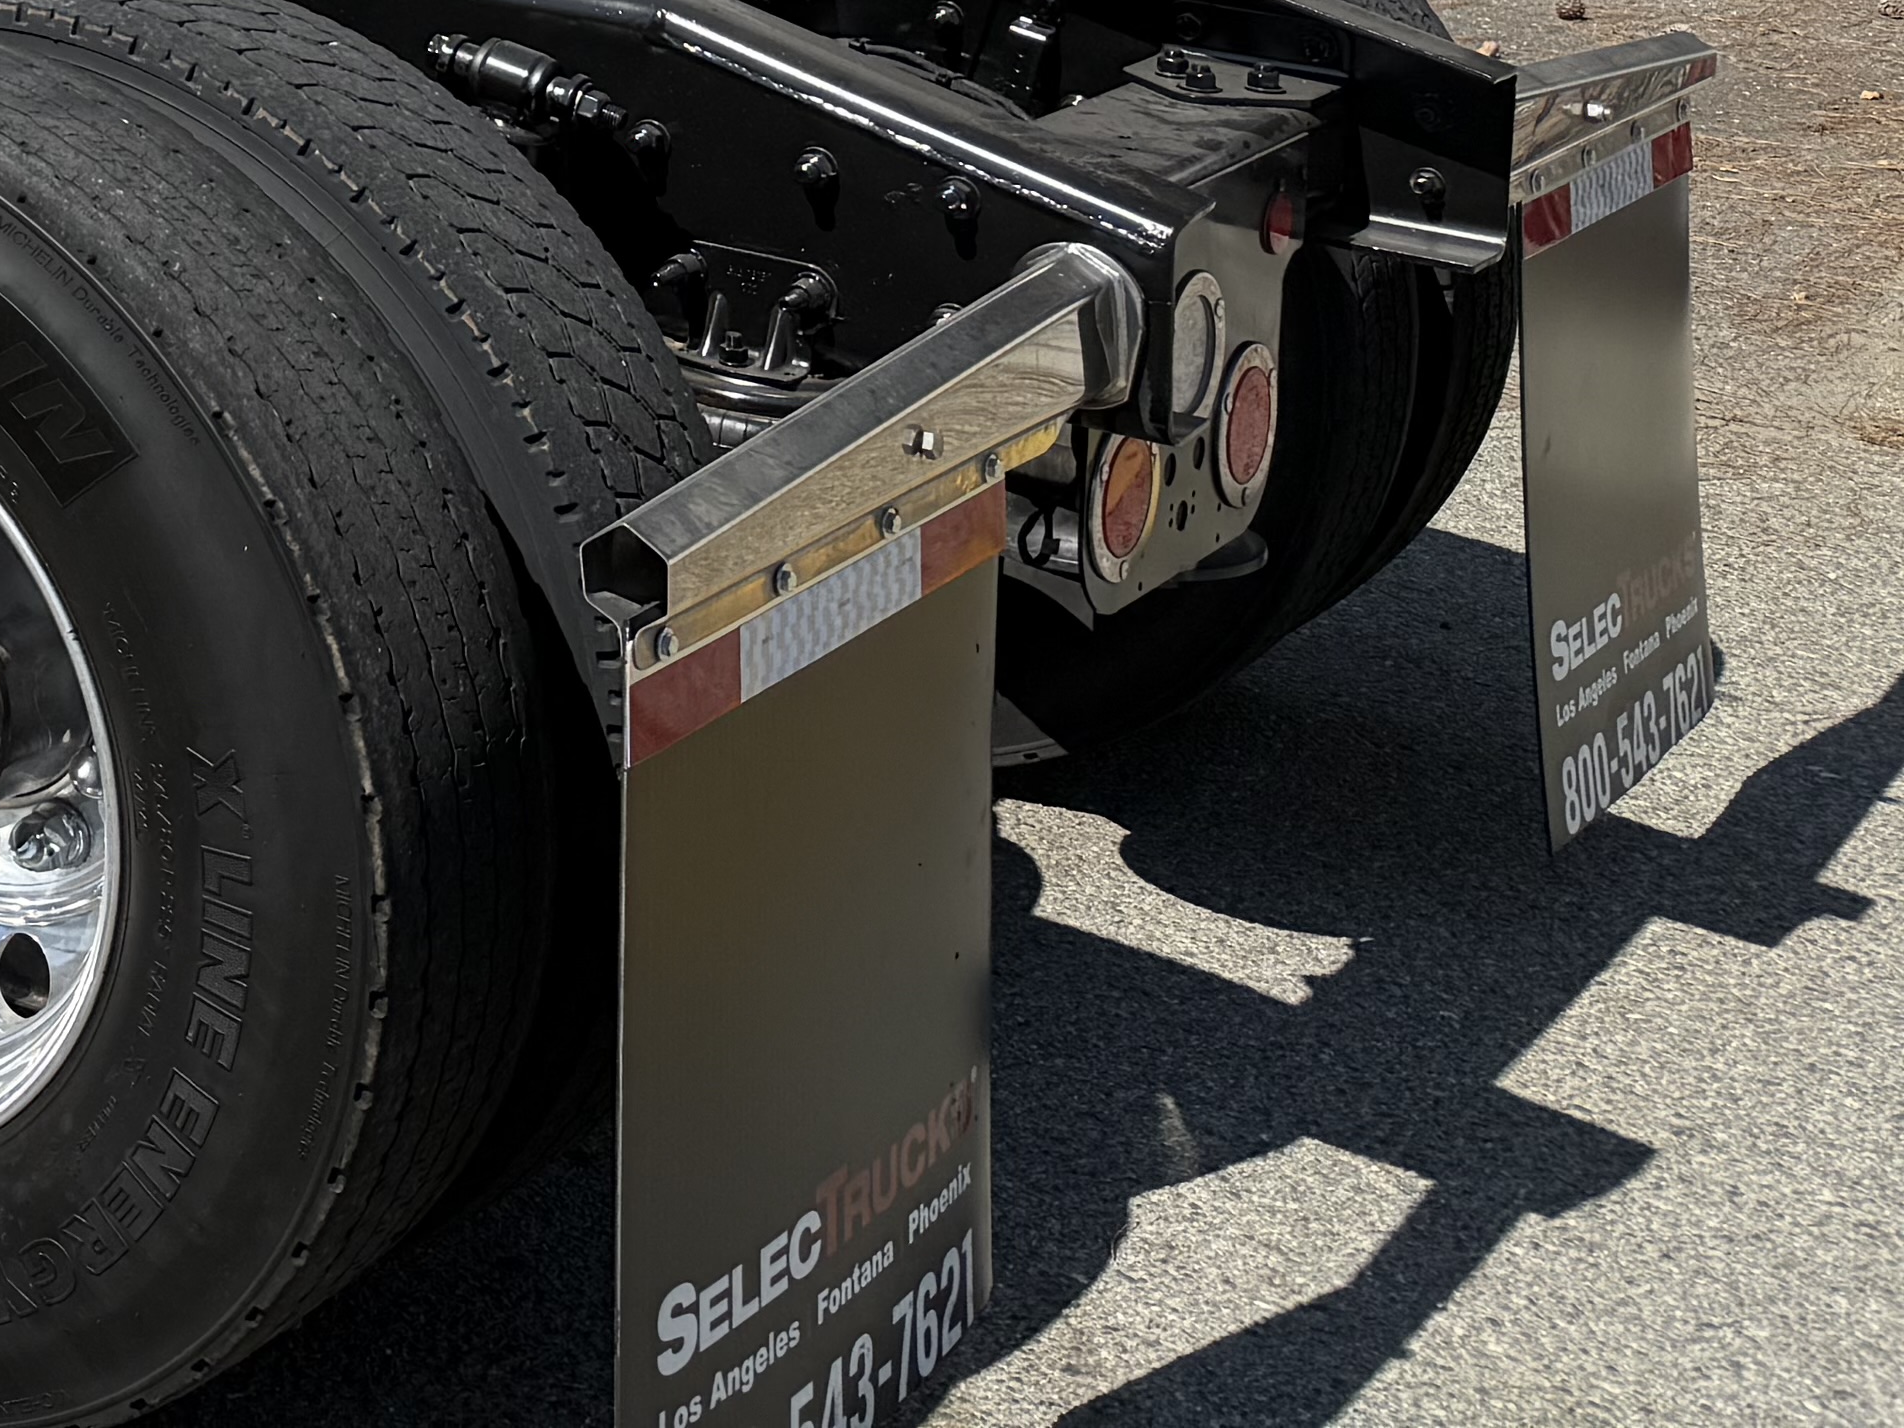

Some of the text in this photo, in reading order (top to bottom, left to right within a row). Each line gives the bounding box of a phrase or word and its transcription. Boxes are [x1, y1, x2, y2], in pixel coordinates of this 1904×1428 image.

[71, 282, 125, 346] Durable
[126, 346, 203, 446] Technologies
[1556, 595, 1699, 728] Los Angeles Fontana Phoenix
[1562, 645, 1709, 835] 800-543-7621
[185, 746, 248, 824] X
[185, 844, 255, 1072] LINE
[710, 1320, 801, 1410] Angeles
[818, 1240, 894, 1326] Fontana
[908, 1161, 972, 1244] Phoenix
